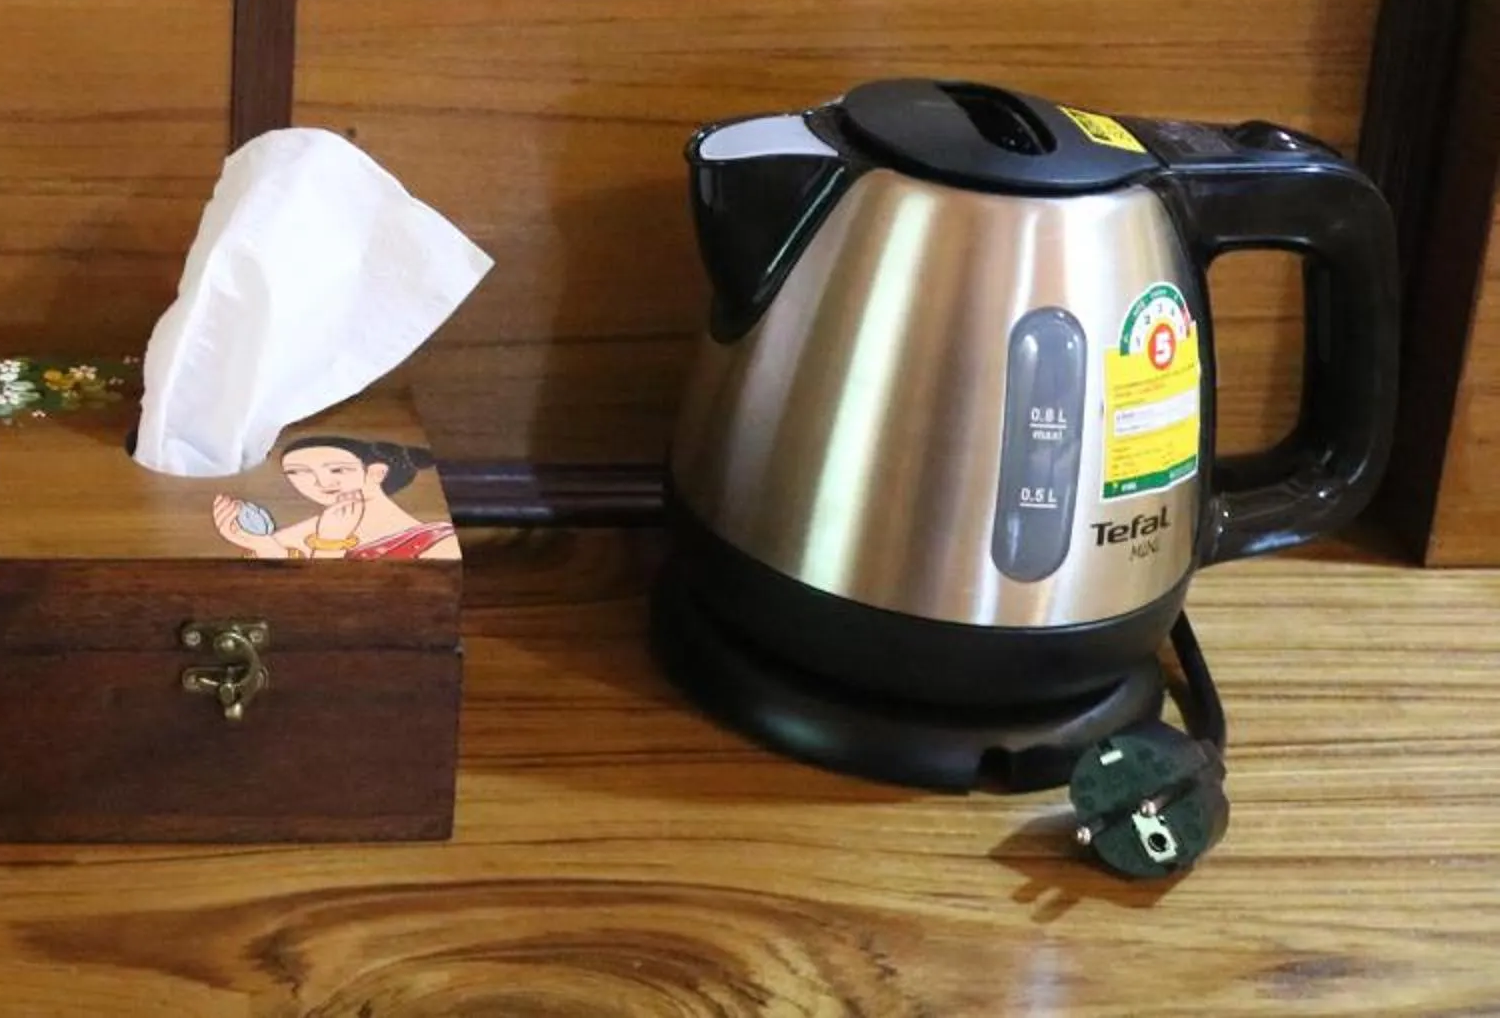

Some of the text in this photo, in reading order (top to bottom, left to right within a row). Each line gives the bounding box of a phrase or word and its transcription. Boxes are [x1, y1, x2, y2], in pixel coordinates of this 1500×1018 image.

[1155, 331, 1172, 364] 5
[1058, 408, 1067, 423] L
[1020, 487, 1057, 503] 0.5 L
[1090, 505, 1170, 547] Tefal
